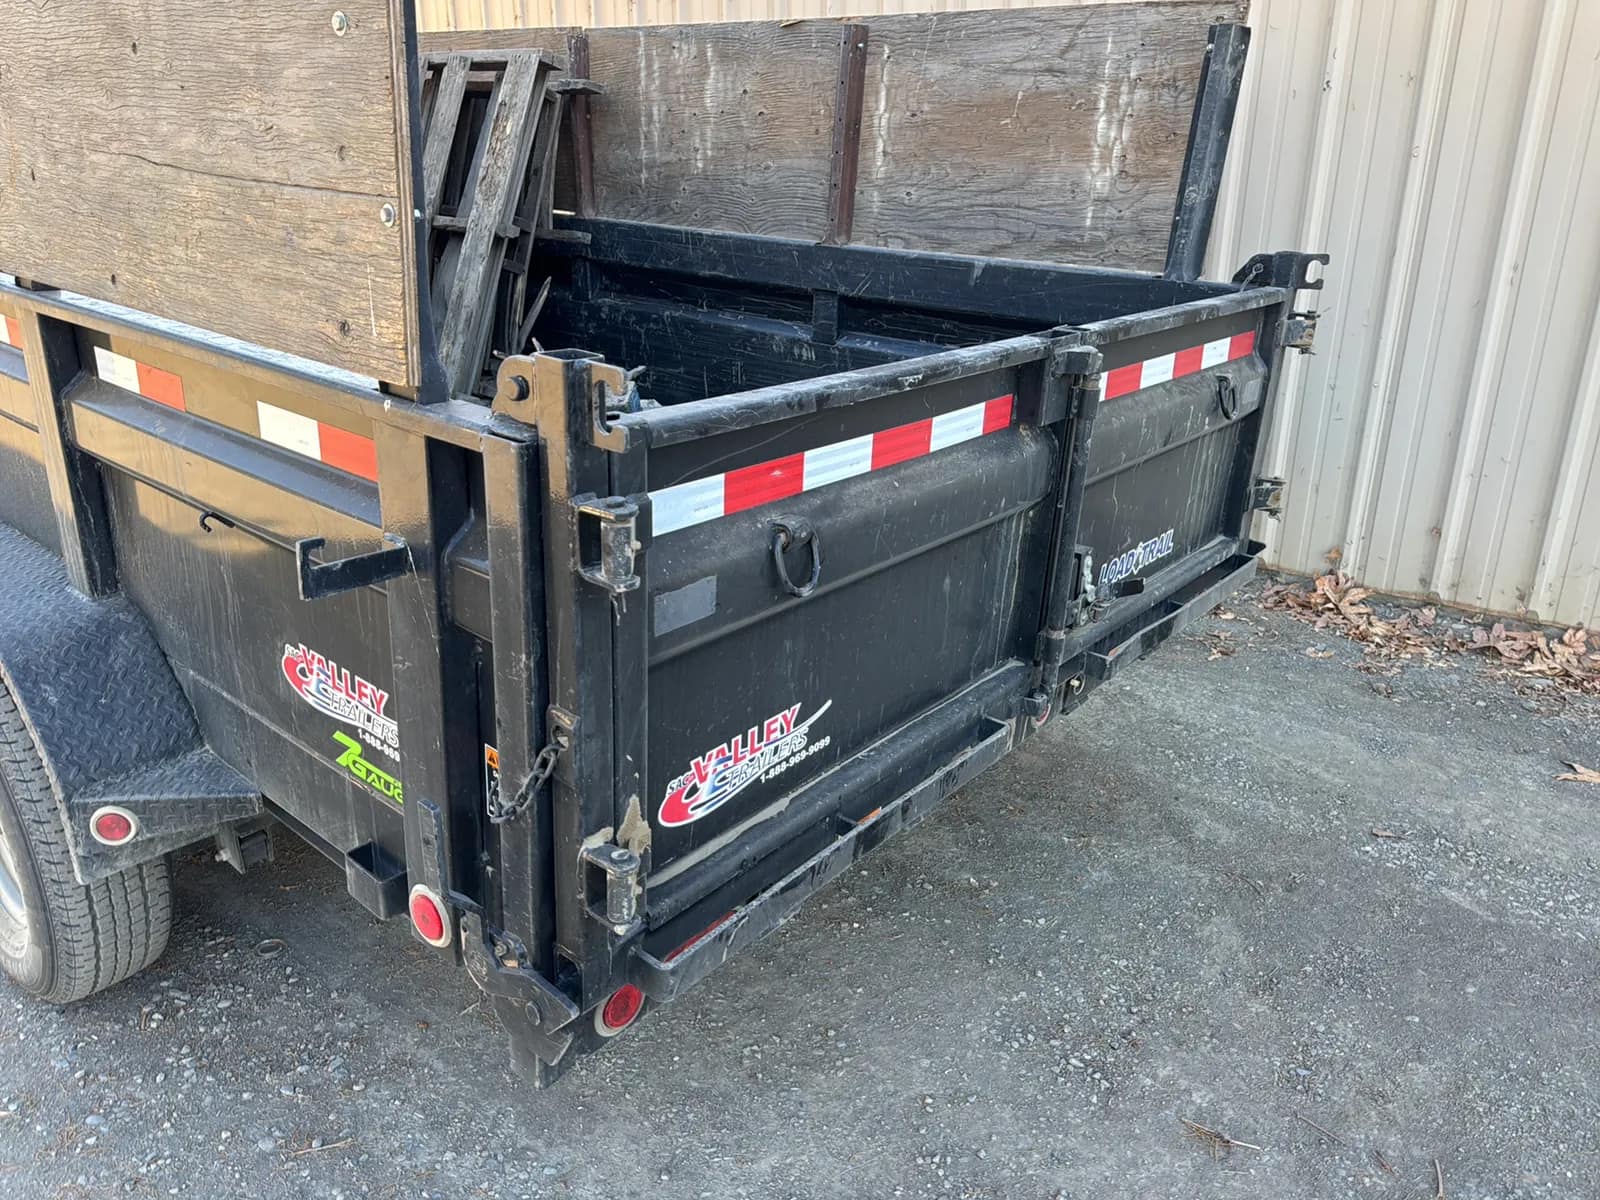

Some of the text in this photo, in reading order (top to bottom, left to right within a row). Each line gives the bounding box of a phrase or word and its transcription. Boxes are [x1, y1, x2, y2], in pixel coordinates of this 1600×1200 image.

[1098, 529, 1174, 585] LOAD TRAIL
[298, 643, 389, 715] VALLEY
[329, 691, 400, 748] TRAILERS
[690, 702, 802, 785] VALLEY
[726, 726, 809, 790] TRAILERS
[759, 735, 831, 784] 1-888-969-9099
